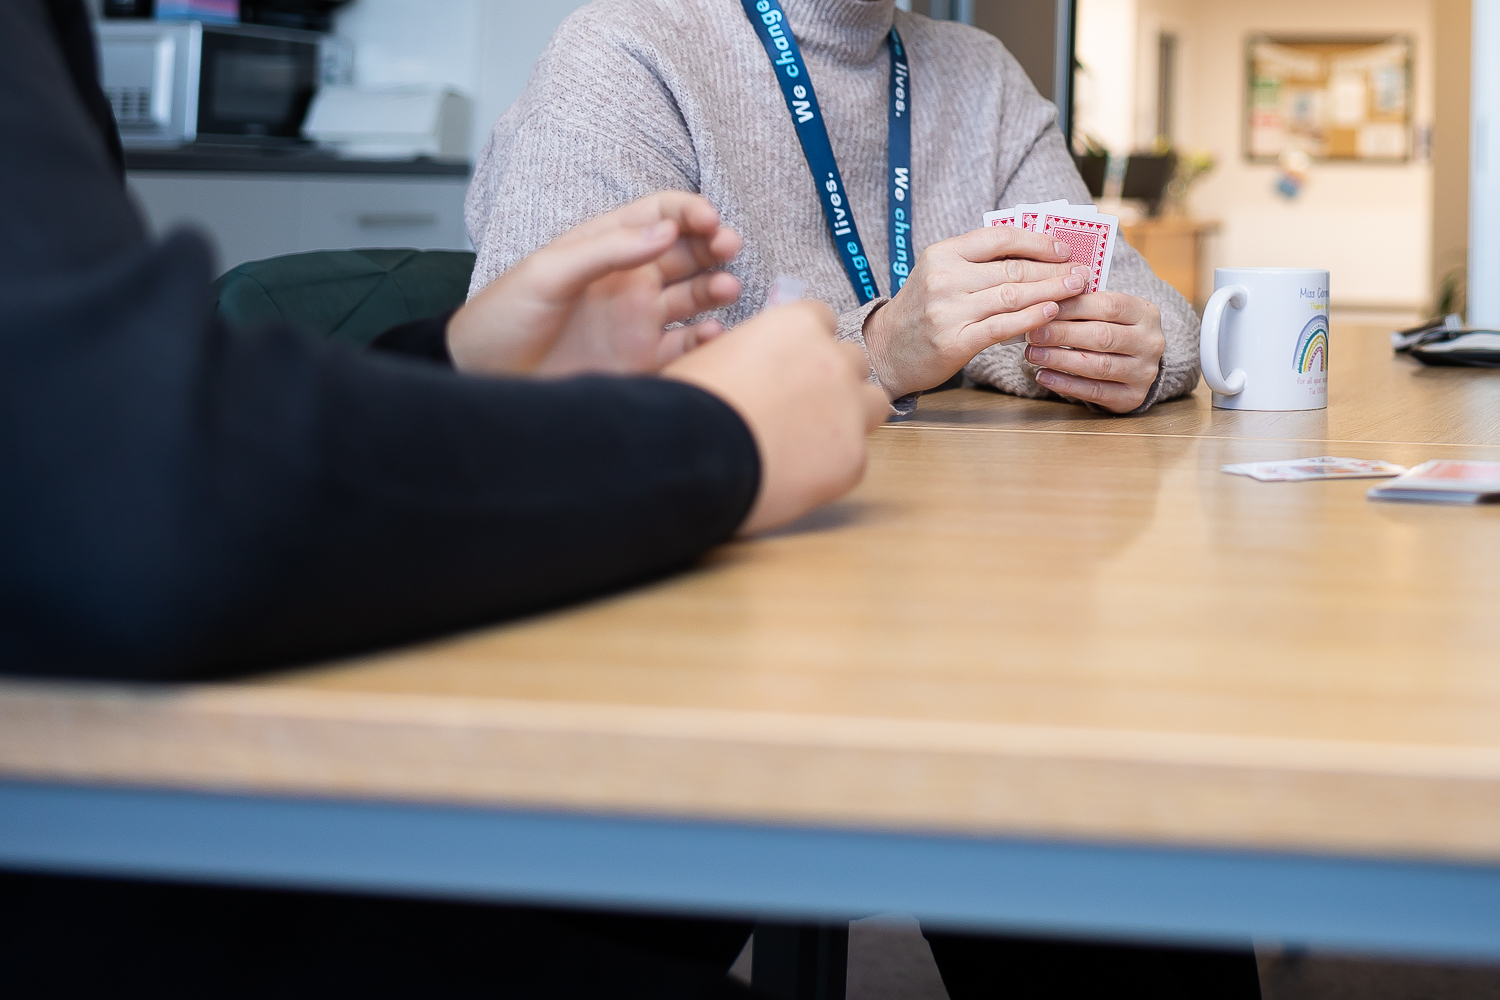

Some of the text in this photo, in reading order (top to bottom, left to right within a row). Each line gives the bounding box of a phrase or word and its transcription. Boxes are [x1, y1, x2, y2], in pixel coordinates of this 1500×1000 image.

[792, 84, 814, 124] We
[895, 61, 908, 118] lives.
[826, 171, 852, 237] lives.
[894, 166, 909, 202] We
[1299, 287, 1315, 298] Miss
